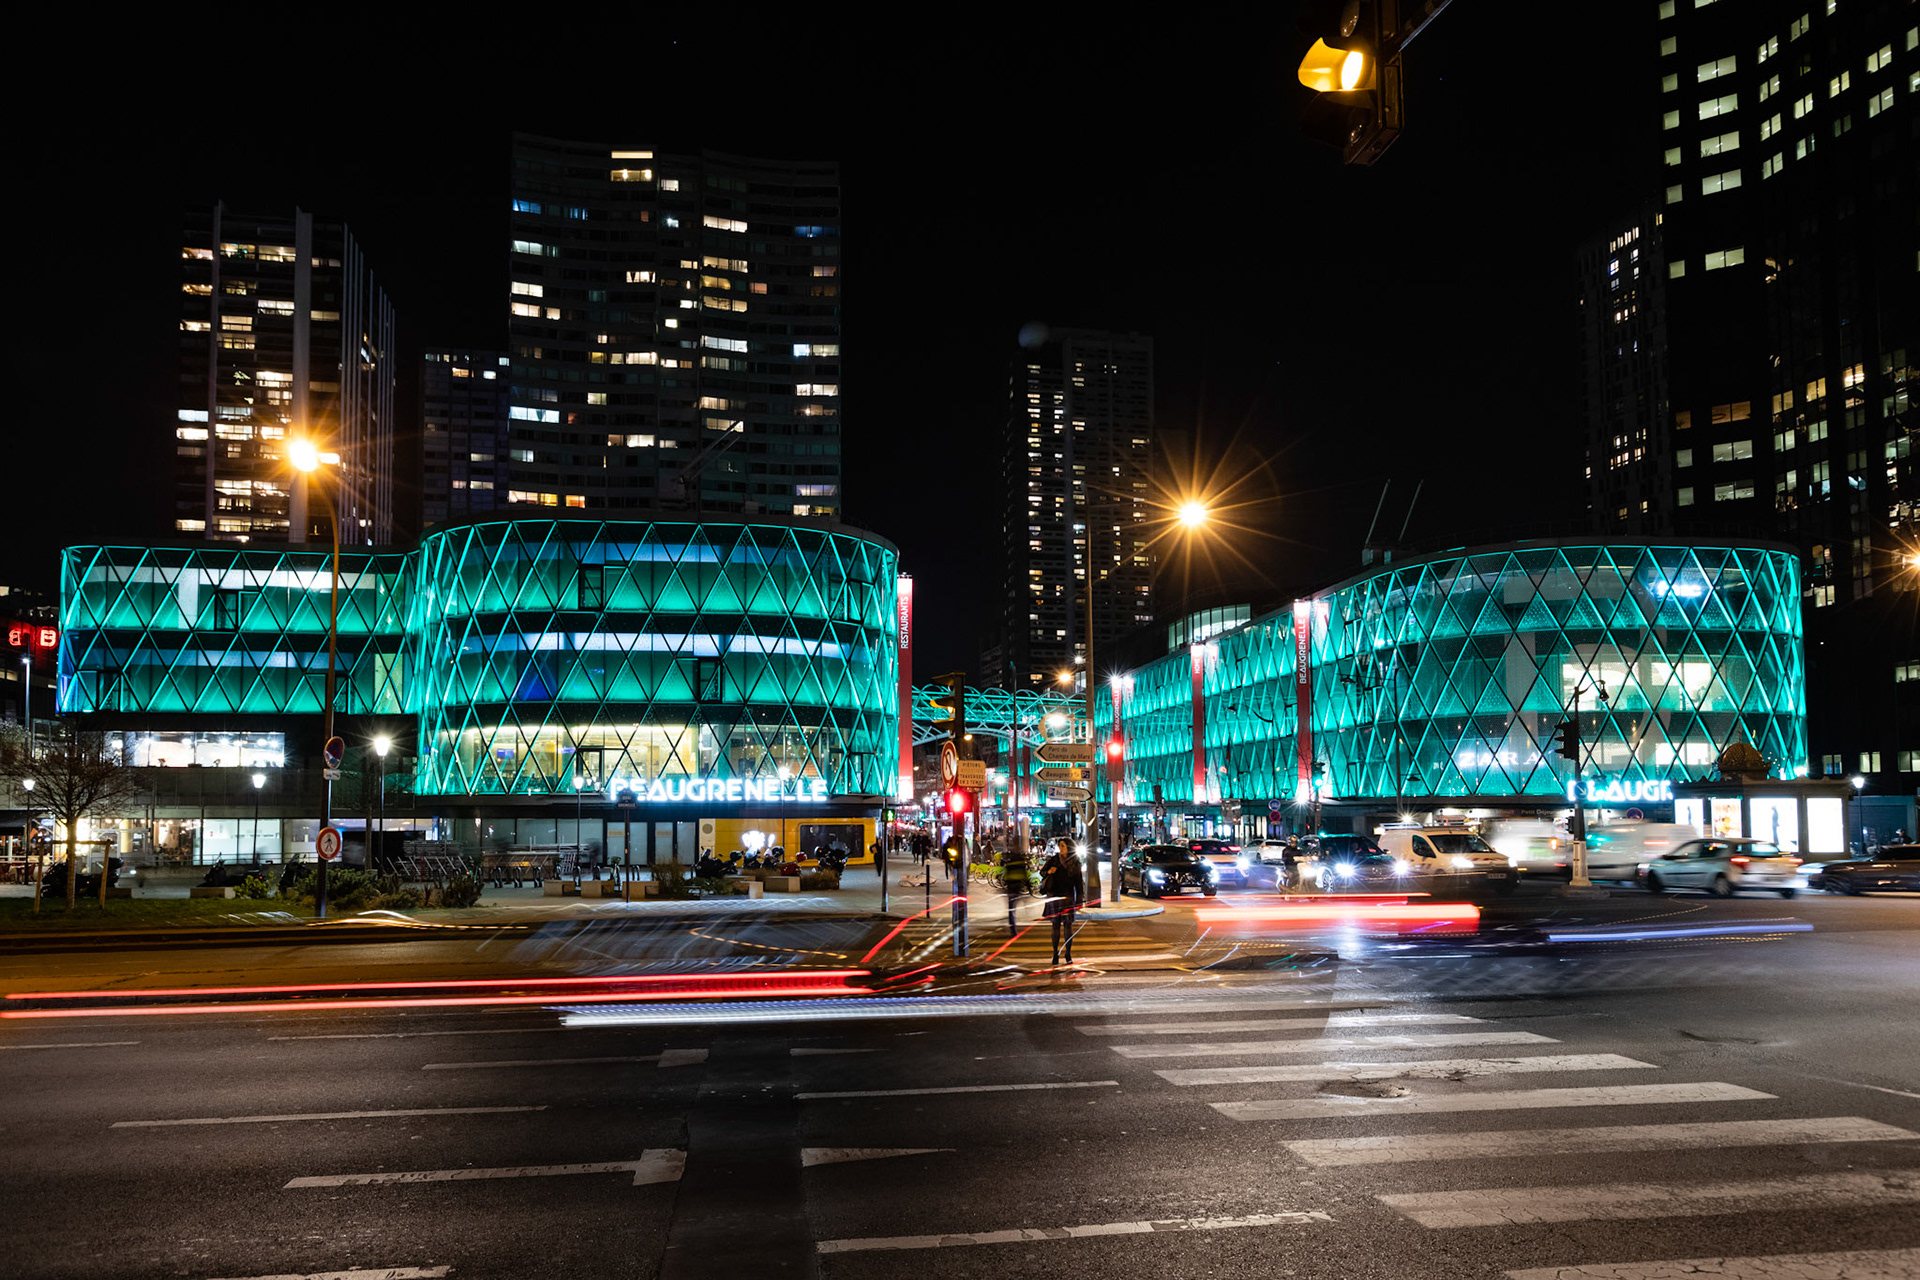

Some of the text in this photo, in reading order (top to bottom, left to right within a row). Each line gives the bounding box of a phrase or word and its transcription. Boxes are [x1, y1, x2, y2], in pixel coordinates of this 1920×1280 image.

[900, 597, 909, 649] RESTAURANTS
[1298, 618, 1307, 684] BEAUGRENELLE
[1458, 751, 1546, 767] ZARA
